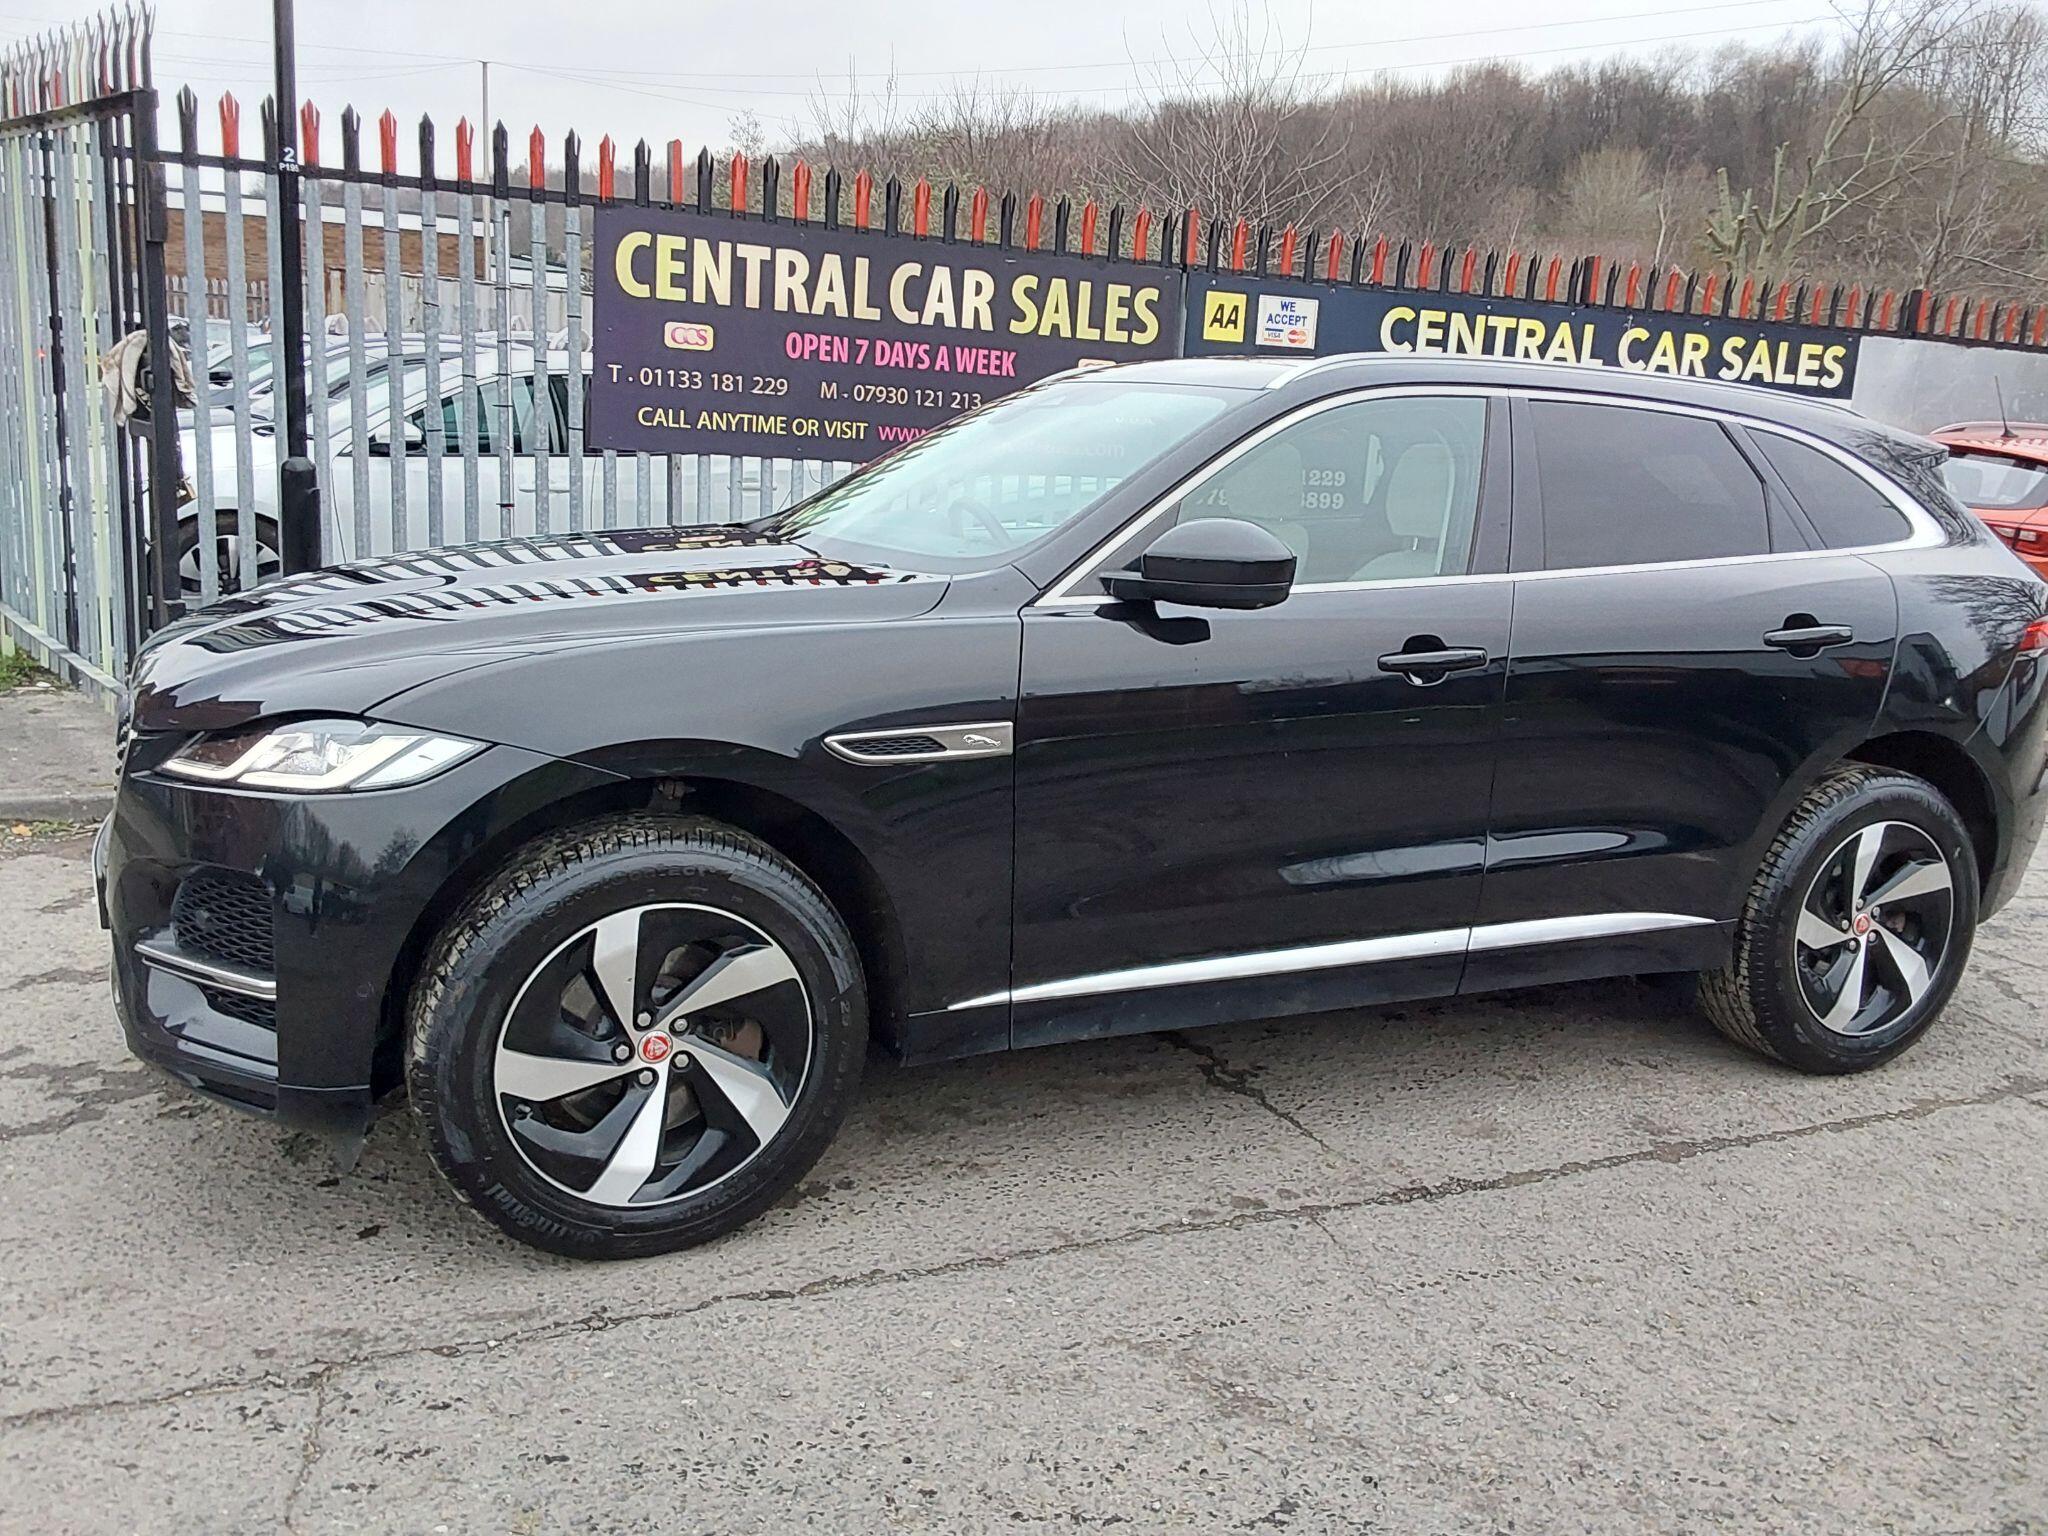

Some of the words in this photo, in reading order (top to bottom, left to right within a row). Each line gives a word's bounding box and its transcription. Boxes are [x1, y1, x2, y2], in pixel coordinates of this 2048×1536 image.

[283, 147, 295, 162] 2
[615, 231, 881, 321] CENTRAL
[889, 262, 995, 331] CAR
[1009, 274, 1160, 345] SALES
[1208, 303, 1240, 330] AA
[1266, 313, 1308, 328] ACCEPT
[1280, 300, 1297, 313] WE
[785, 331, 849, 364] OPEN
[855, 338, 870, 365] 7
[875, 340, 931, 370] DAYS
[934, 345, 951, 372] A
[955, 346, 1017, 377] WEEK
[1380, 306, 1603, 367] CENTRAL
[1618, 327, 1710, 377] CAR
[1718, 336, 1846, 389] SALES
[639, 367, 703, 390] 01133
[711, 373, 744, 393] 181
[750, 376, 788, 396] 229
[853, 384, 909, 405] 07930
[915, 389, 943, 408] 121
[950, 392, 982, 411] 213
[637, 406, 692, 429] CALL
[696, 411, 788, 435] ANYTIME
[792, 418, 819, 437] OR
[824, 420, 869, 440] VISIT
